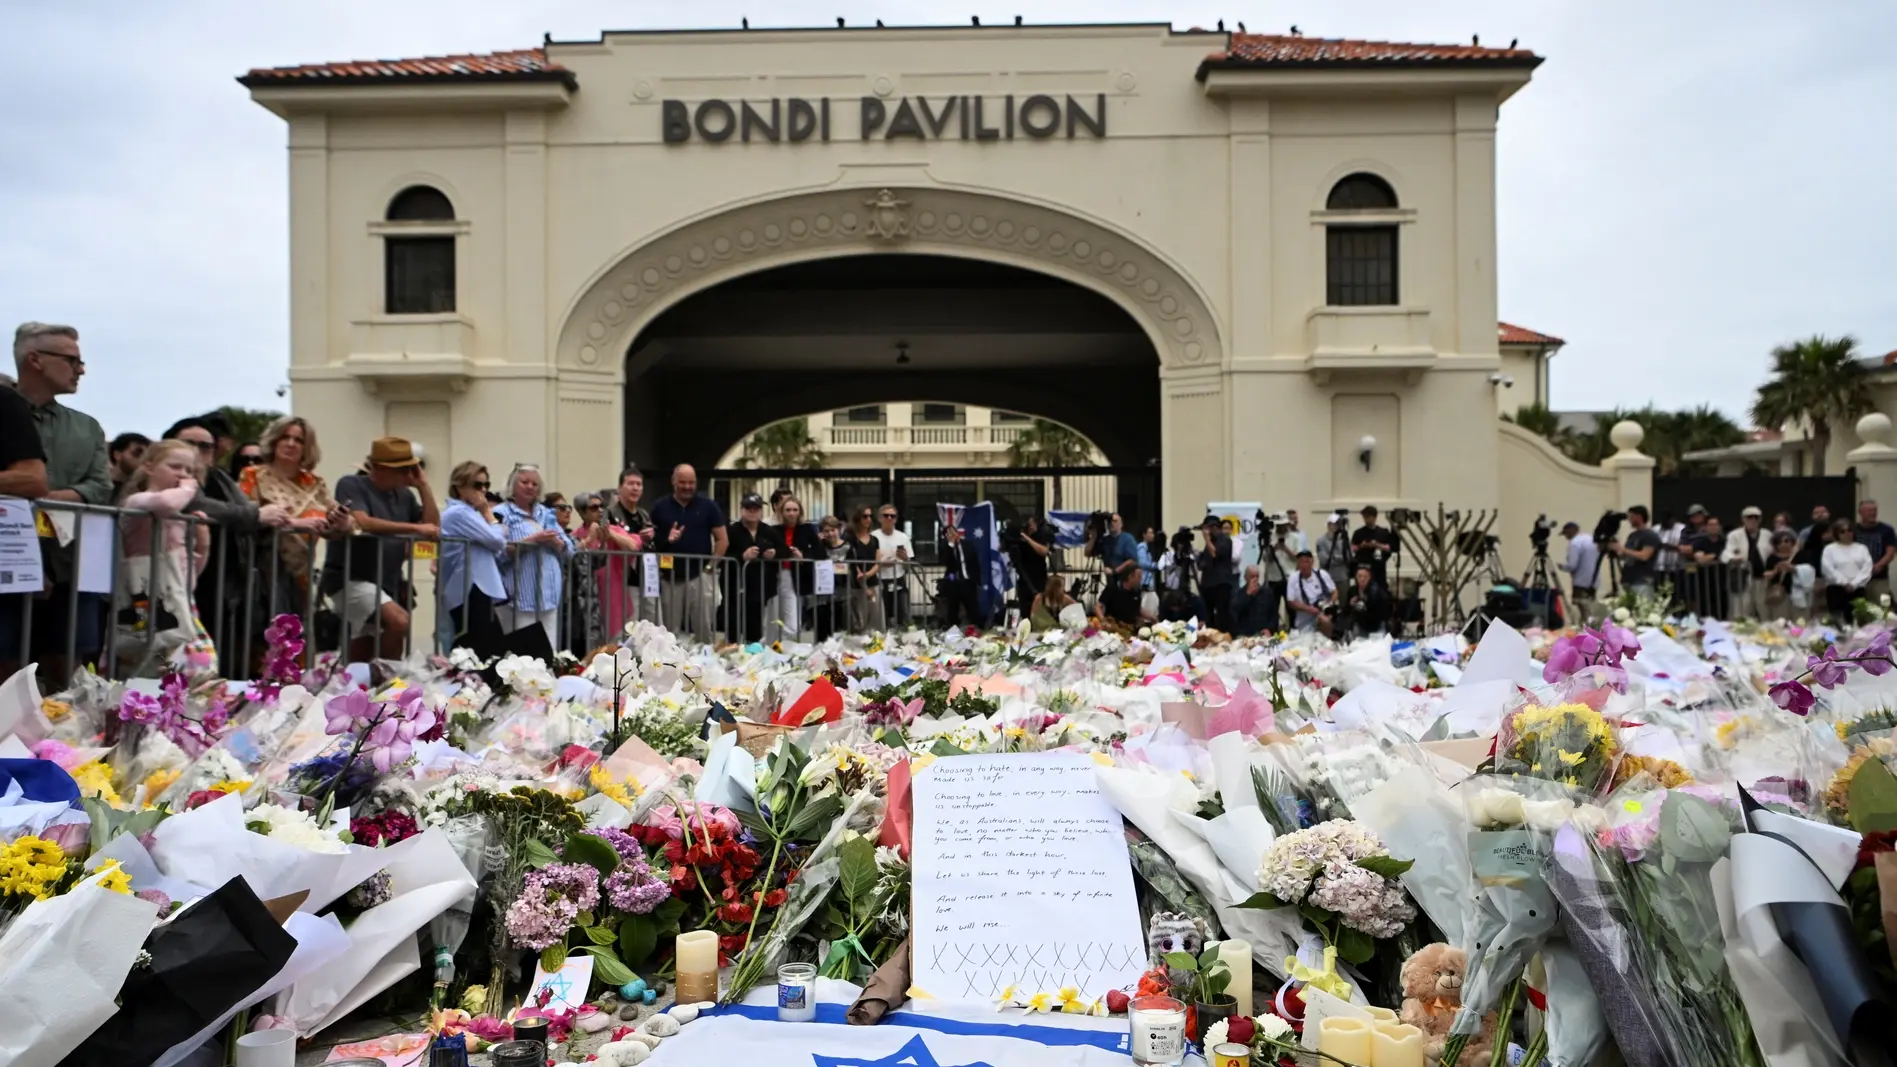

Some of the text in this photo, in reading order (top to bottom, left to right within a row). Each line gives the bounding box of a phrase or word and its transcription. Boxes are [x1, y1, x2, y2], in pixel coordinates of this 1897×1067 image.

[662, 93, 1106, 143] BONDI PAVILION
[933, 766, 972, 775] Choosing
[983, 773, 1004, 783] safer
[935, 793, 970, 803] Choosing
[1027, 869, 1045, 879] light
[1050, 869, 1061, 878] of
[1073, 891, 1080, 901] of
[959, 922, 975, 931] will
